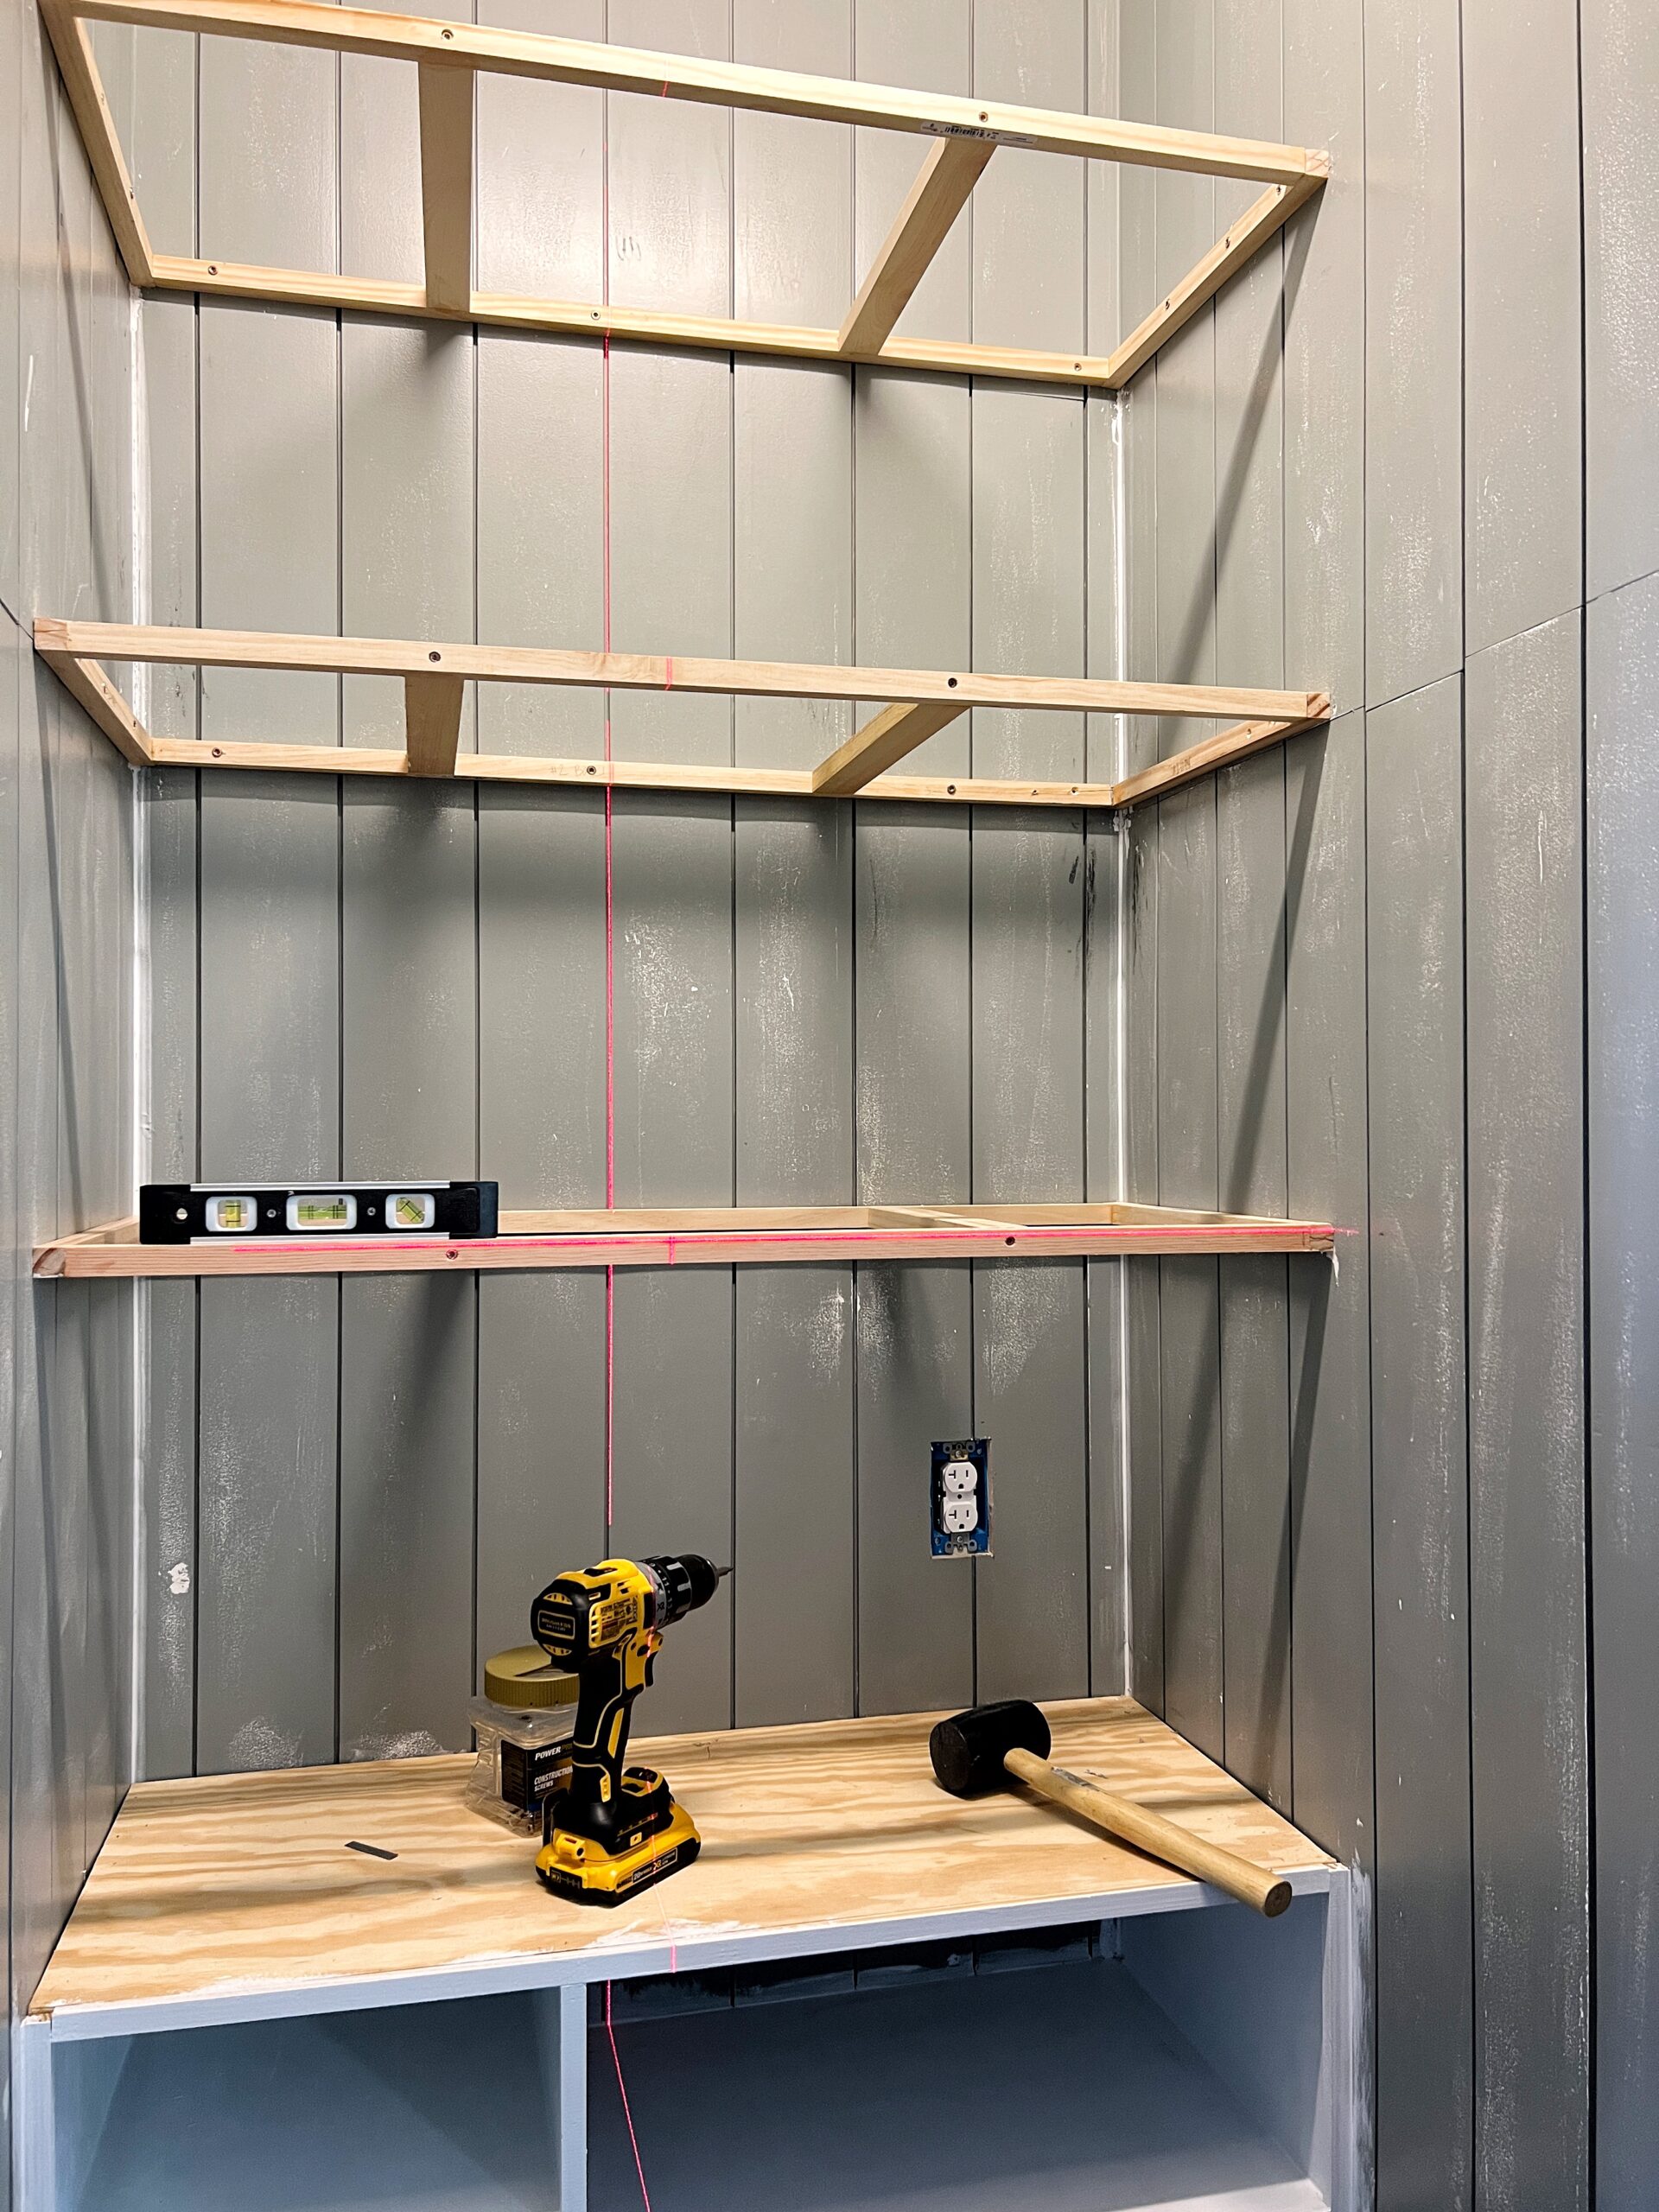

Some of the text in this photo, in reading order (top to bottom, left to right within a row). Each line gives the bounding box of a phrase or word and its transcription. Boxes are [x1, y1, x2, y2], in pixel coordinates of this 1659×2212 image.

[534, 1745, 562, 1761] POWER
[534, 1765, 574, 1785] CONSTRUCTION
[534, 1780, 554, 1792] SCREWS
